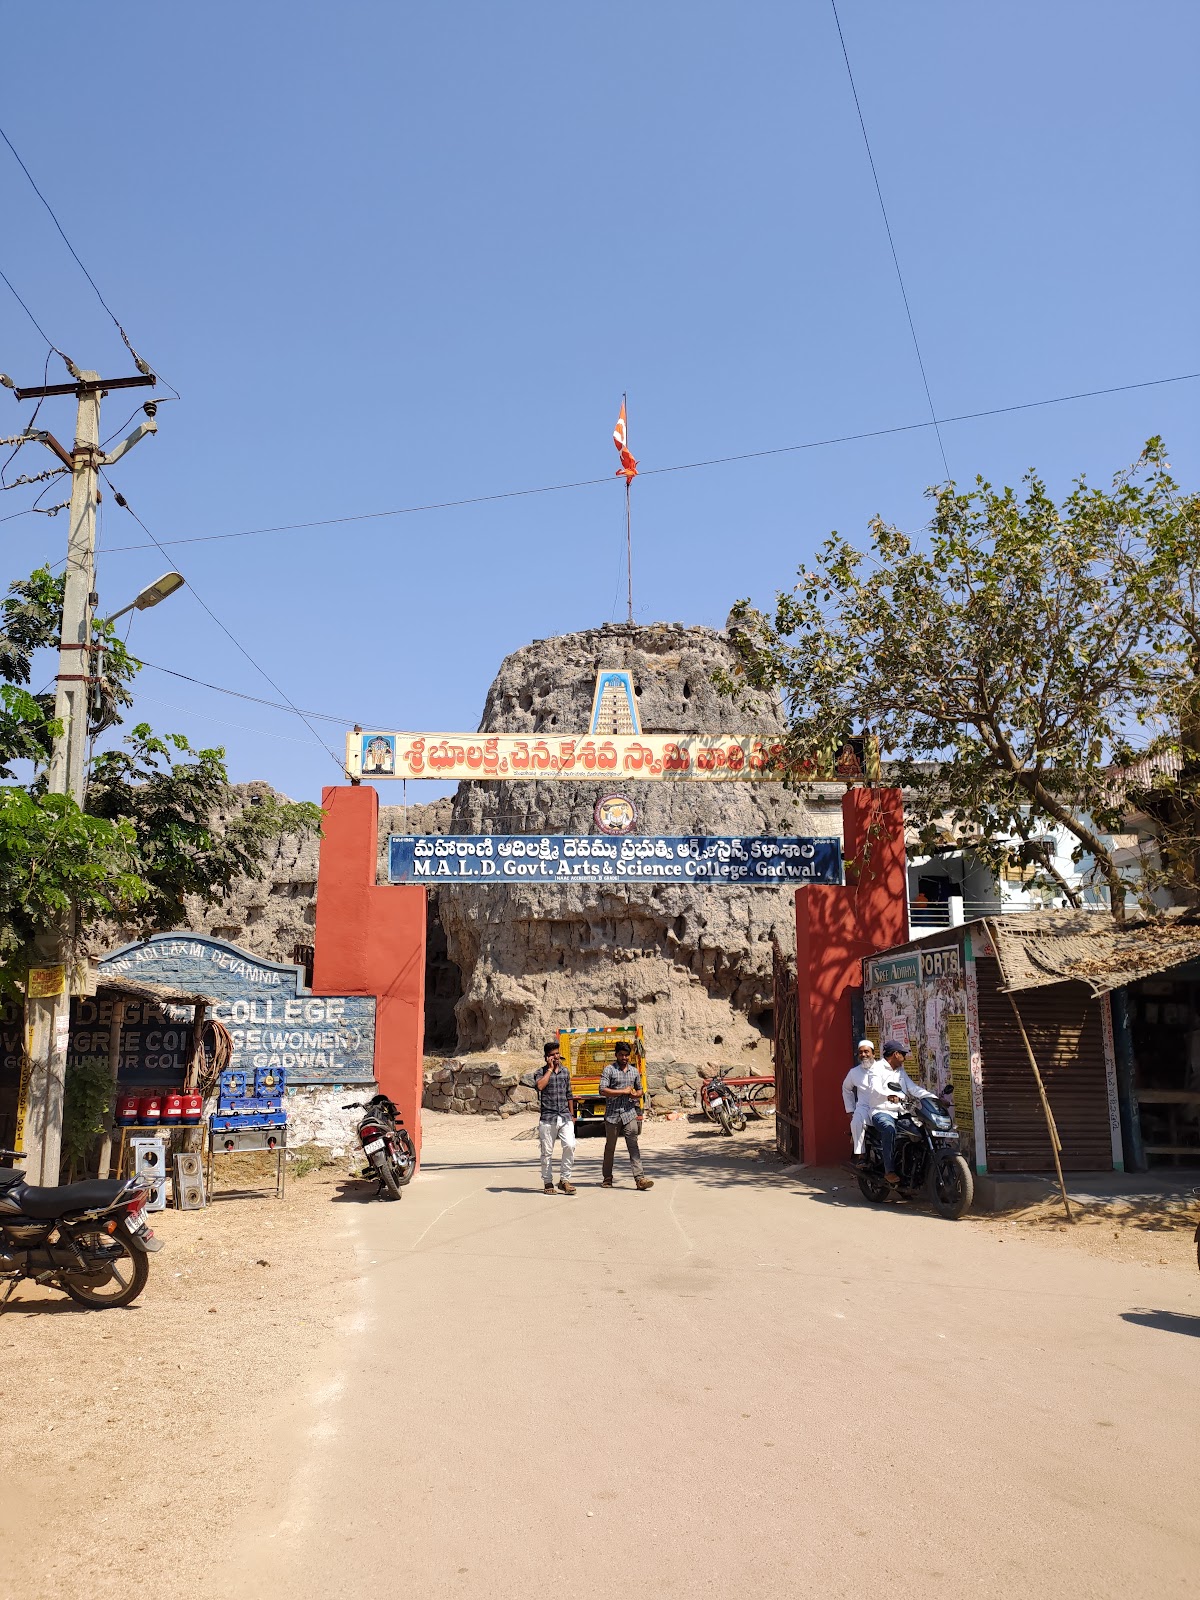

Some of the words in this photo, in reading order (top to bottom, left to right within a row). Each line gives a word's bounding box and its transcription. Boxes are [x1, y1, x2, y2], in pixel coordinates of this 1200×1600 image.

[413, 838, 494, 857] మహారాణి
[563, 839, 618, 859] దేవమ్మ
[620, 839, 674, 860] ప్రభుత్వ
[751, 839, 815, 859] కళాశాల
[503, 859, 554, 876] Govt.
[556, 859, 600, 876] Arts
[602, 861, 613, 875] &
[616, 860, 682, 876] Science
[136, 947, 159, 964] ADI
[163, 942, 205, 959] LAXMI
[211, 949, 281, 984] DEVAMMA
[211, 999, 345, 1024] COLLEGE
[252, 1053, 345, 1068] GADWAL
